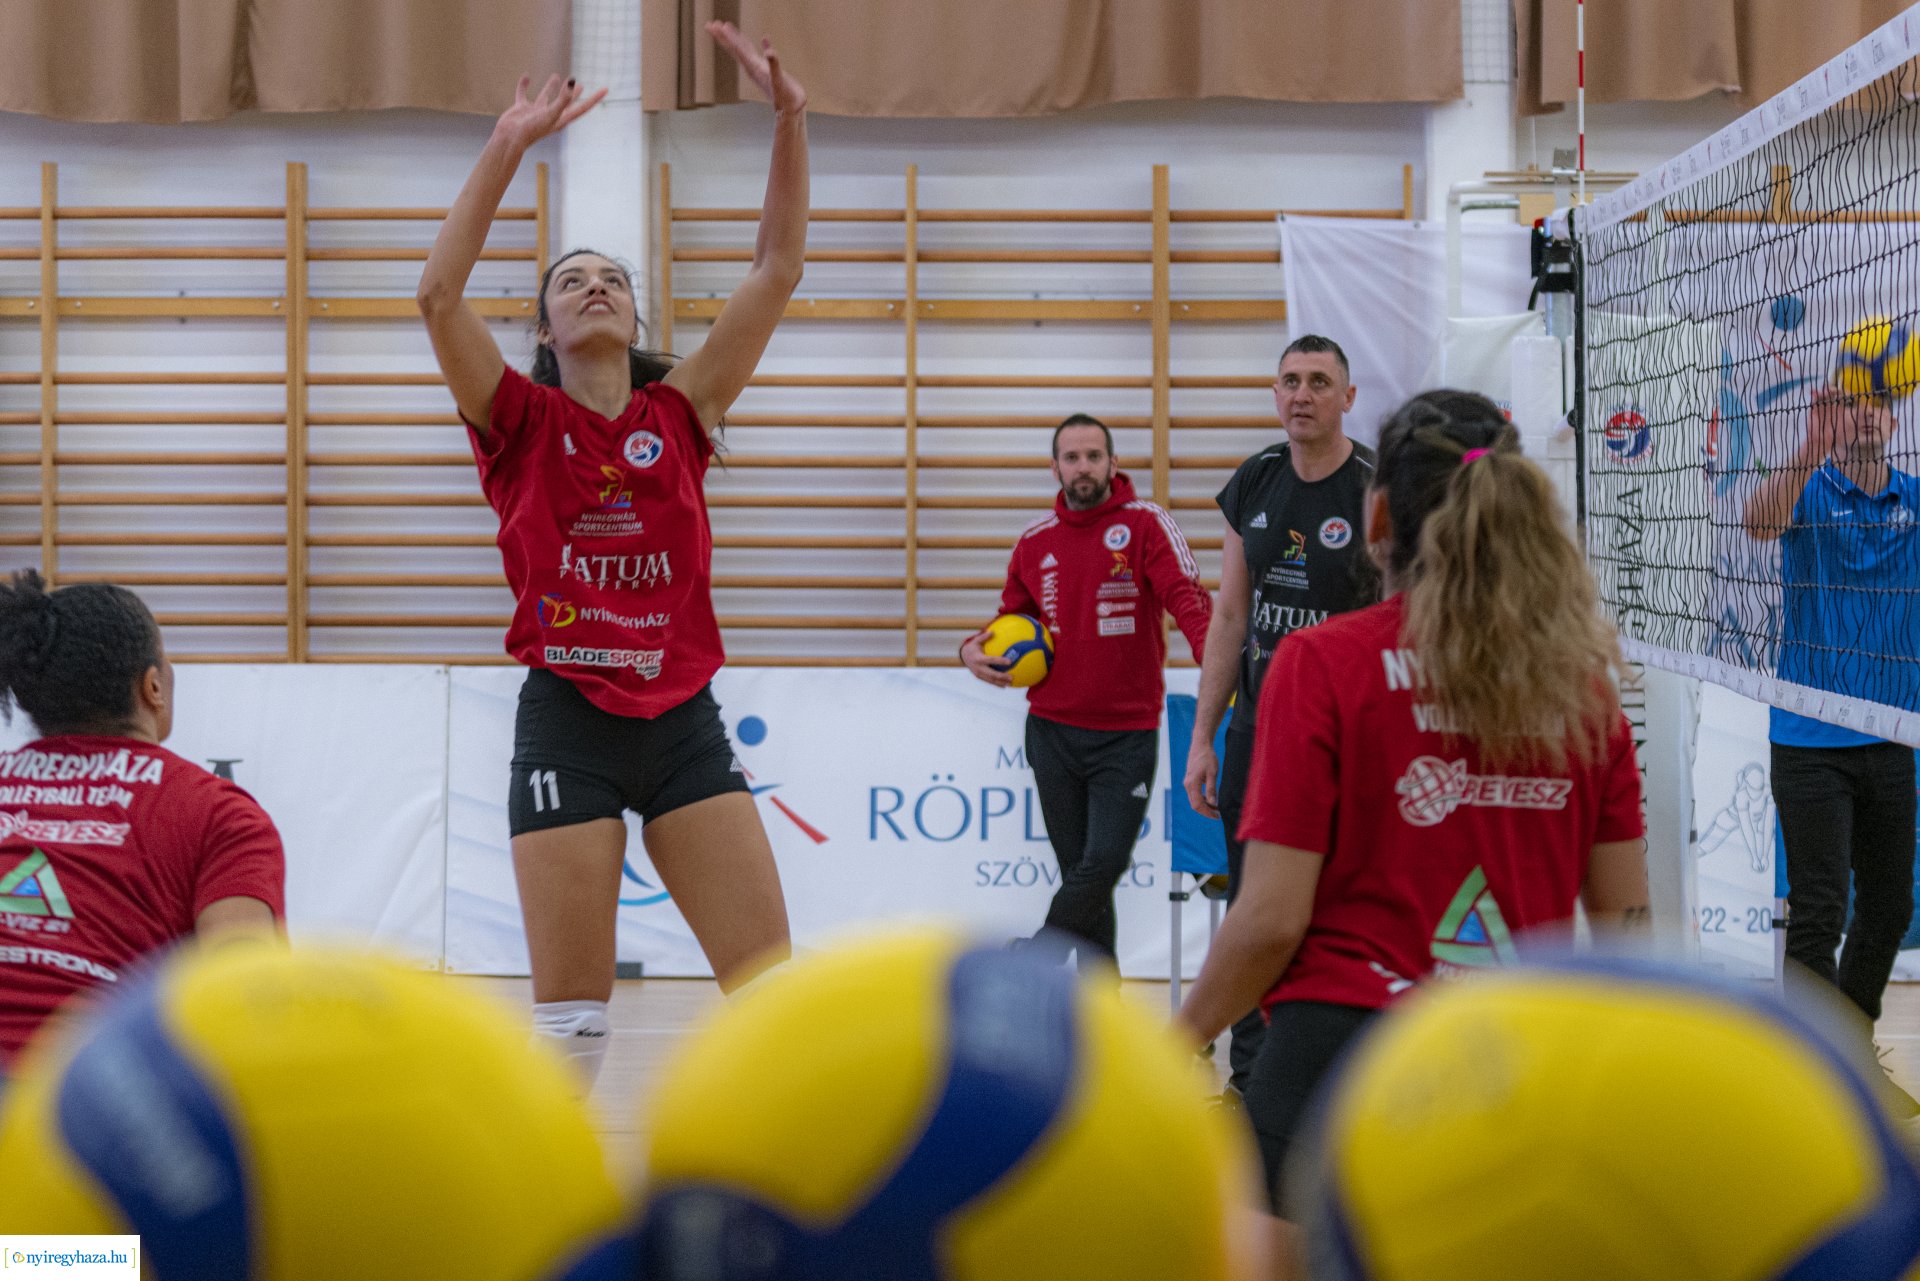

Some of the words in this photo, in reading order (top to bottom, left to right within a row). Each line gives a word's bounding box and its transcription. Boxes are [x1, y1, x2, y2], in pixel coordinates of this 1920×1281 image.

[0, 748, 163, 785] YÍREGYHÁZA
[529, 769, 561, 812] 11
[1701, 906, 1727, 933] 22
